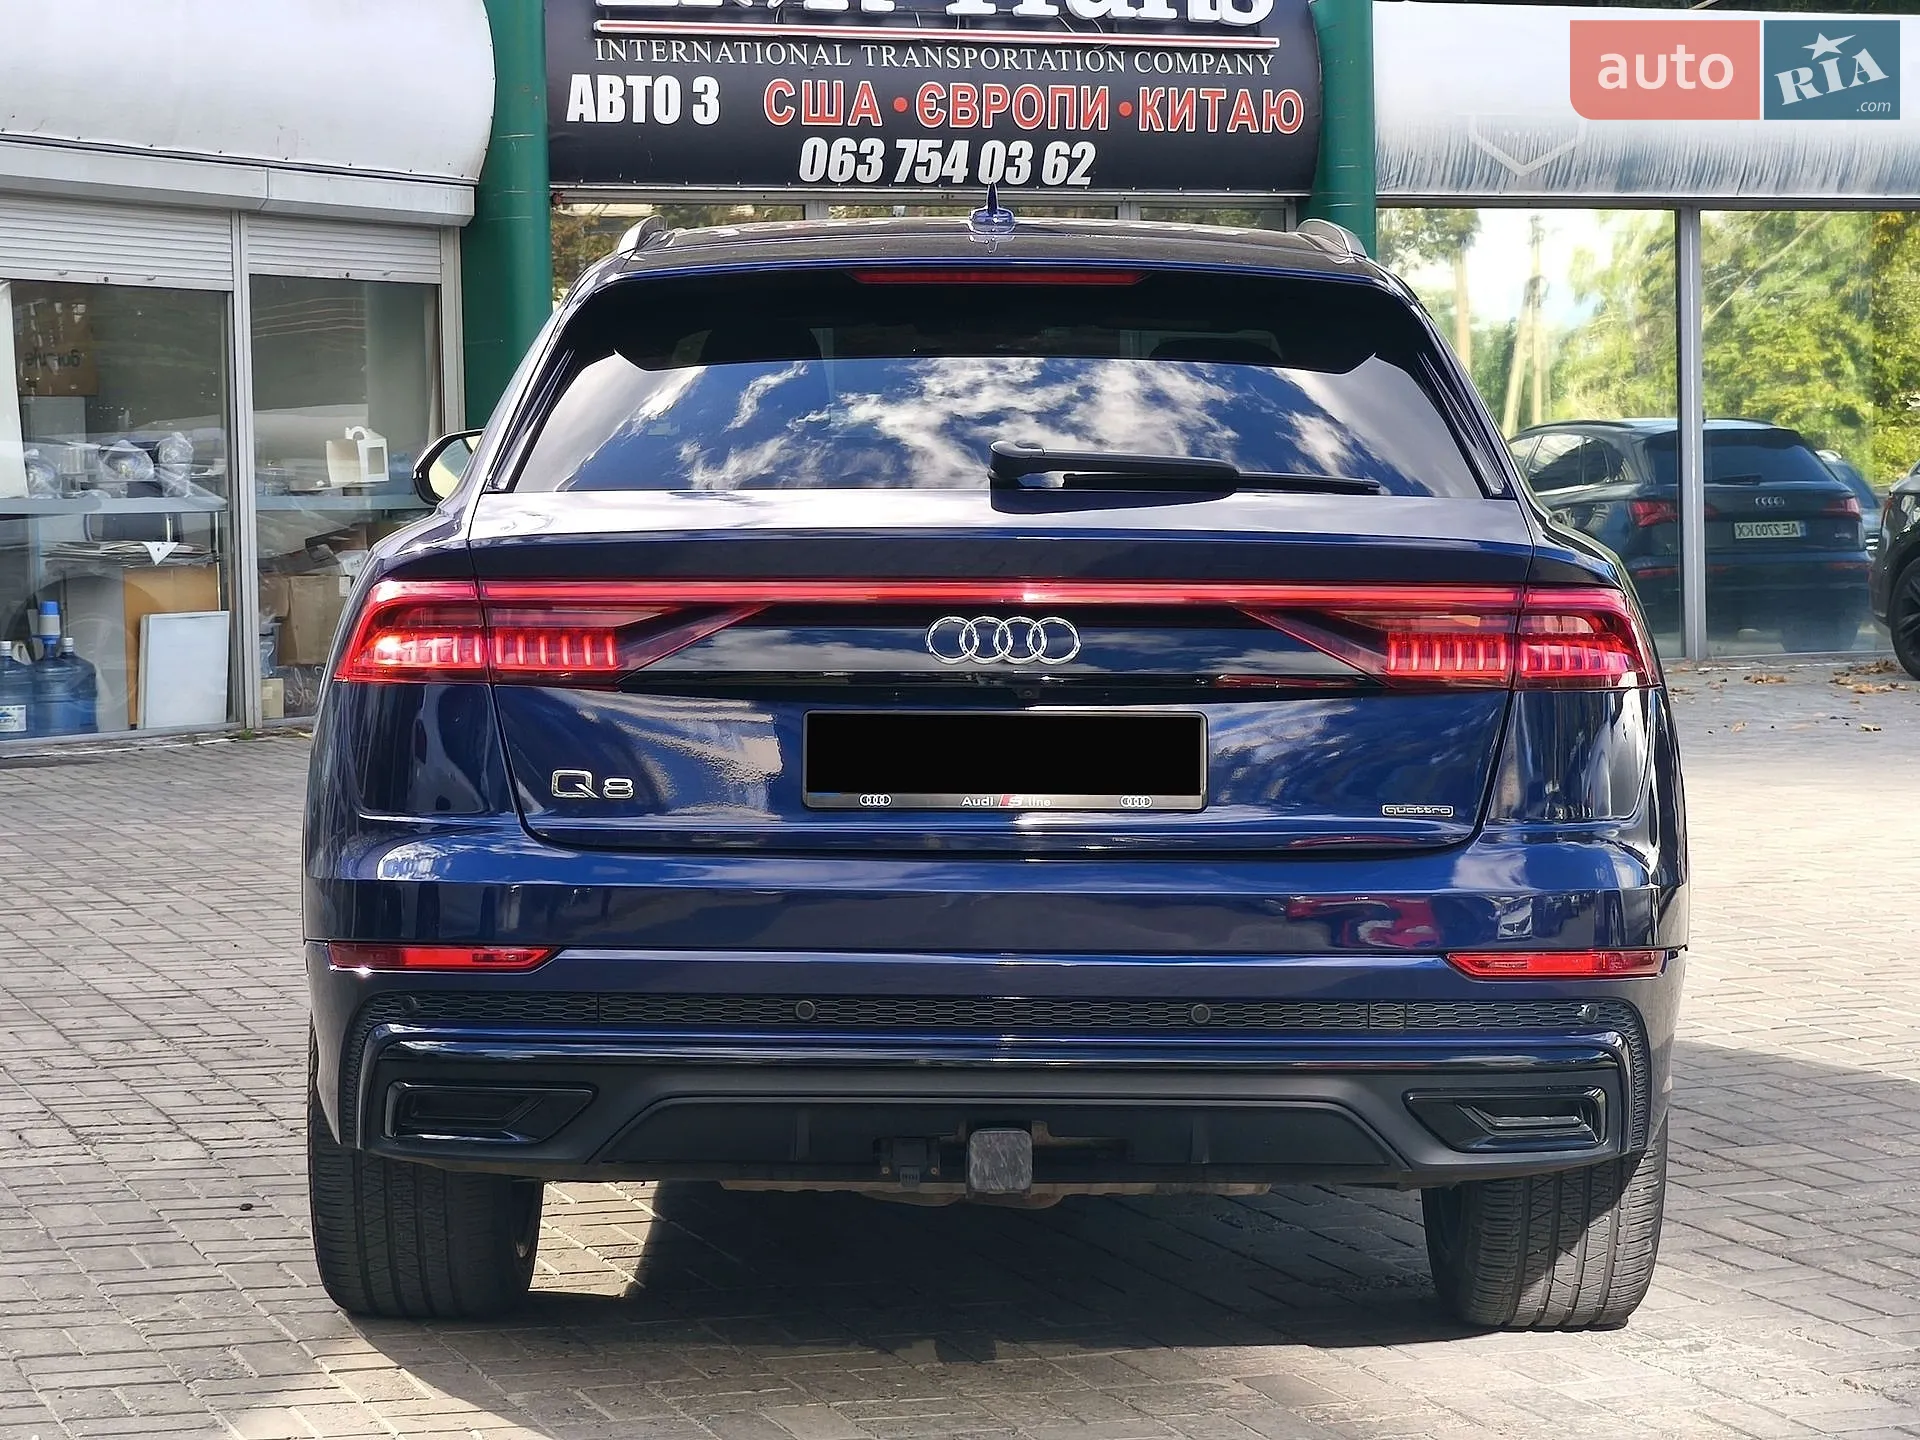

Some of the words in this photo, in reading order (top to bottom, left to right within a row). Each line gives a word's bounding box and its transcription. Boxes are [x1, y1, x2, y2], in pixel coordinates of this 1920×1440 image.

[594, 38, 853, 67] INTERNATIONAL
[861, 45, 1126, 74] TRANSPORTATION
[1134, 51, 1275, 76] COMPANY
[565, 74, 682, 125] АВТО
[763, 78, 884, 127] США
[915, 80, 1110, 132] ЄВРОПИ
[1138, 85, 1305, 135] КИТАЮ
[799, 136, 886, 184] 063
[893, 138, 970, 185] 754
[977, 139, 1035, 186] 03
[1041, 140, 1098, 187] 62
[551, 769, 635, 799] Q8
[961, 796, 994, 806] Audi
[1385, 806, 1451, 815] quattro
